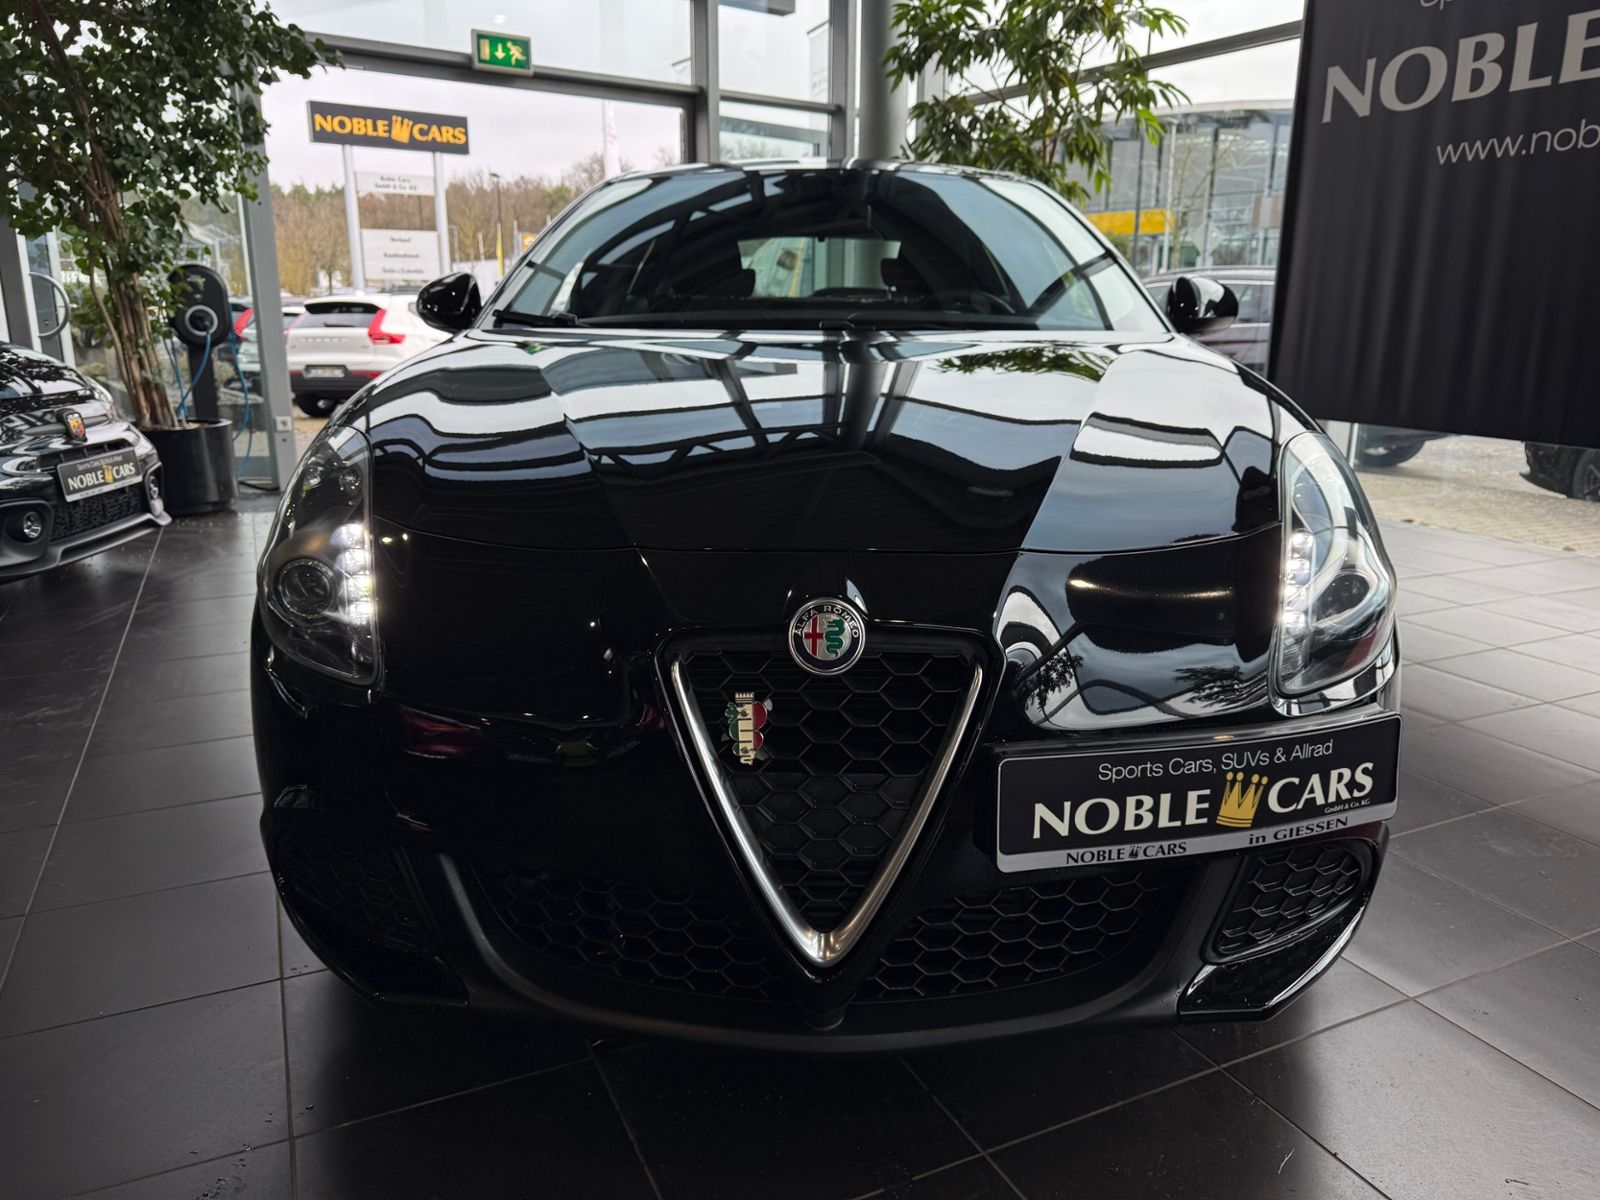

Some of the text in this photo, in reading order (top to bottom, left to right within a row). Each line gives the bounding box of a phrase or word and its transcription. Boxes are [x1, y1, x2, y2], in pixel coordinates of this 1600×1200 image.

[1321, 9, 1600, 124] NOBLE
[313, 113, 467, 145] NOBLE CARS
[67, 470, 105, 491] NOBLE
[112, 462, 136, 479] CARS
[794, 605, 860, 638] ALFA ROMEO
[1098, 739, 1334, 783] Sports Cars, SUVs & Allrad
[1032, 761, 1374, 840] NOBLE CARS
[1248, 816, 1349, 846] in GIESSEN
[1065, 842, 1188, 865] NOBLE CARS
